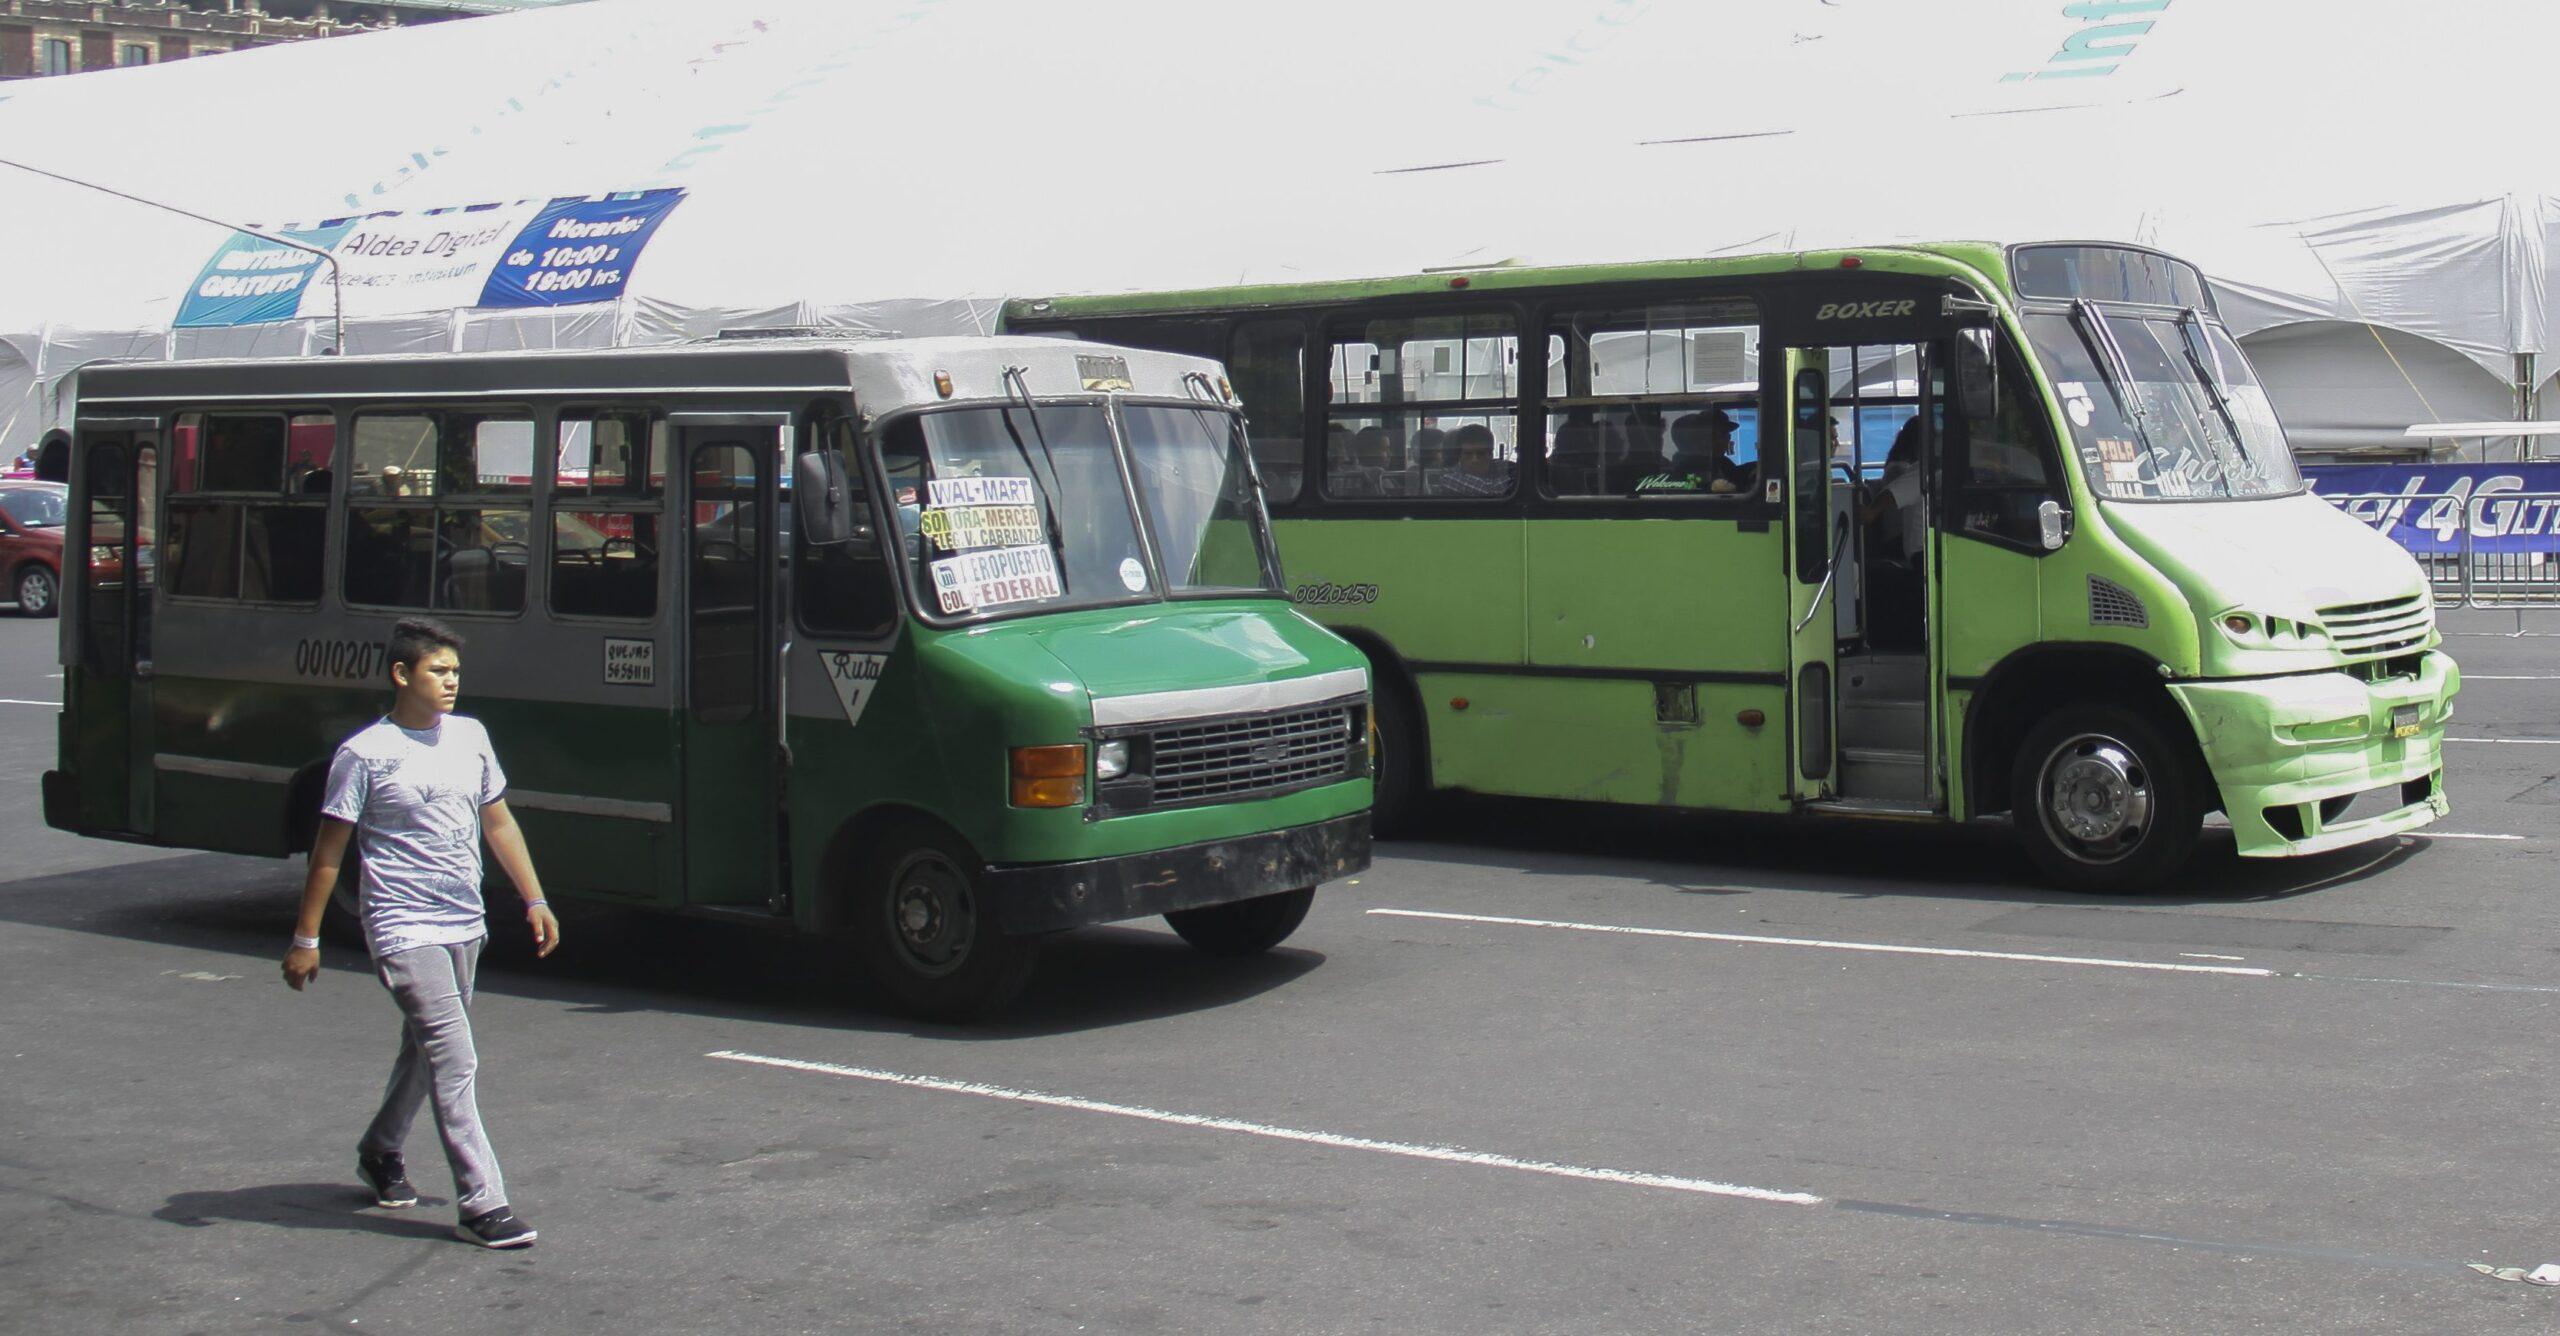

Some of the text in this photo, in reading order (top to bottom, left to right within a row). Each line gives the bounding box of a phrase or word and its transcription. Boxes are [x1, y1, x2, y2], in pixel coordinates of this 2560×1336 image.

[342, 221, 511, 258] Aldea Digital
[548, 216, 646, 239] Horario:
[507, 248, 534, 266] de
[541, 244, 607, 268] 10:00
[525, 268, 621, 292] 19:00 hrs.
[1816, 299, 1916, 320] BOXER
[972, 576, 1058, 606] FEDERAL
[1295, 583, 1379, 605] 0020150
[297, 639, 387, 679] 0010207
[608, 644, 651, 660] QUEJAS
[833, 652, 882, 680] Ruta
